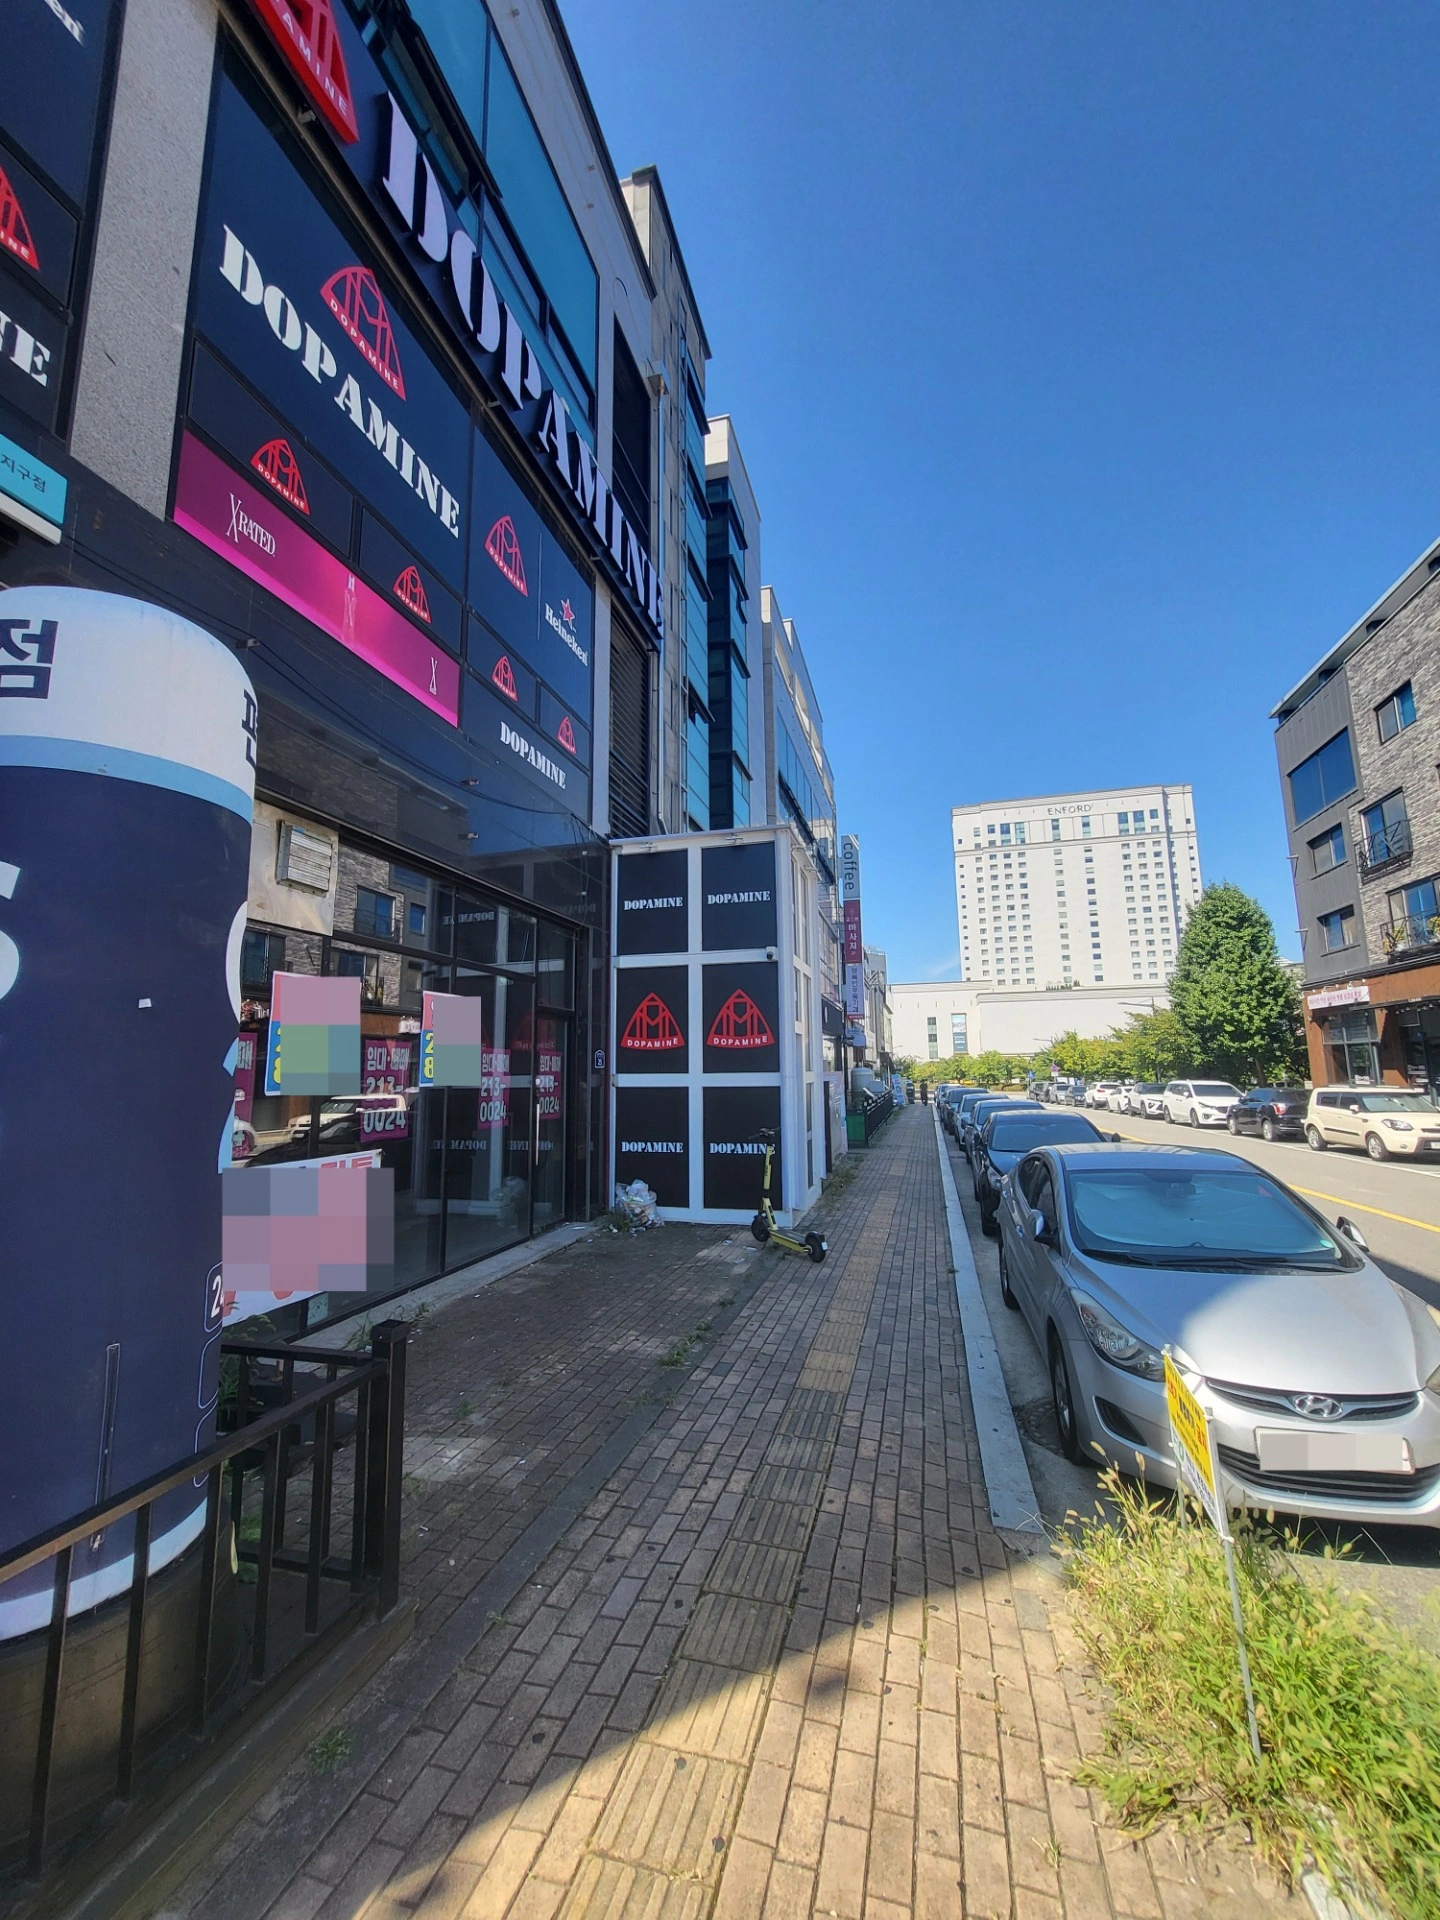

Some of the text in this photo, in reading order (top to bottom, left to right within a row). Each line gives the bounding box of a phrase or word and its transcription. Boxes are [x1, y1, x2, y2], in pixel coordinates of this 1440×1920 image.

[276, 0, 348, 117] AMINE
[330, 297, 399, 390] DOPAMINE
[382, 91, 664, 640] DOPAMINE
[219, 224, 459, 538] DOPAMINE
[258, 464, 304, 509] DOPAMINE
[489, 547, 524, 591] DOPAMINE
[545, 603, 588, 666] Heineken
[500, 721, 566, 790] DOPAMINE
[1047, 804, 1092, 816] ENFORD
[843, 842, 857, 890] coffee
[624, 897, 683, 910] DOPAMINE
[708, 891, 771, 904] DOPAMINE
[627, 1038, 679, 1048] DOPAMINE
[713, 1035, 768, 1046] DOPAMINE
[364, 1107, 406, 1133] 0024
[480, 1100, 506, 1122] 0024
[621, 1141, 684, 1153] DOPAMINE
